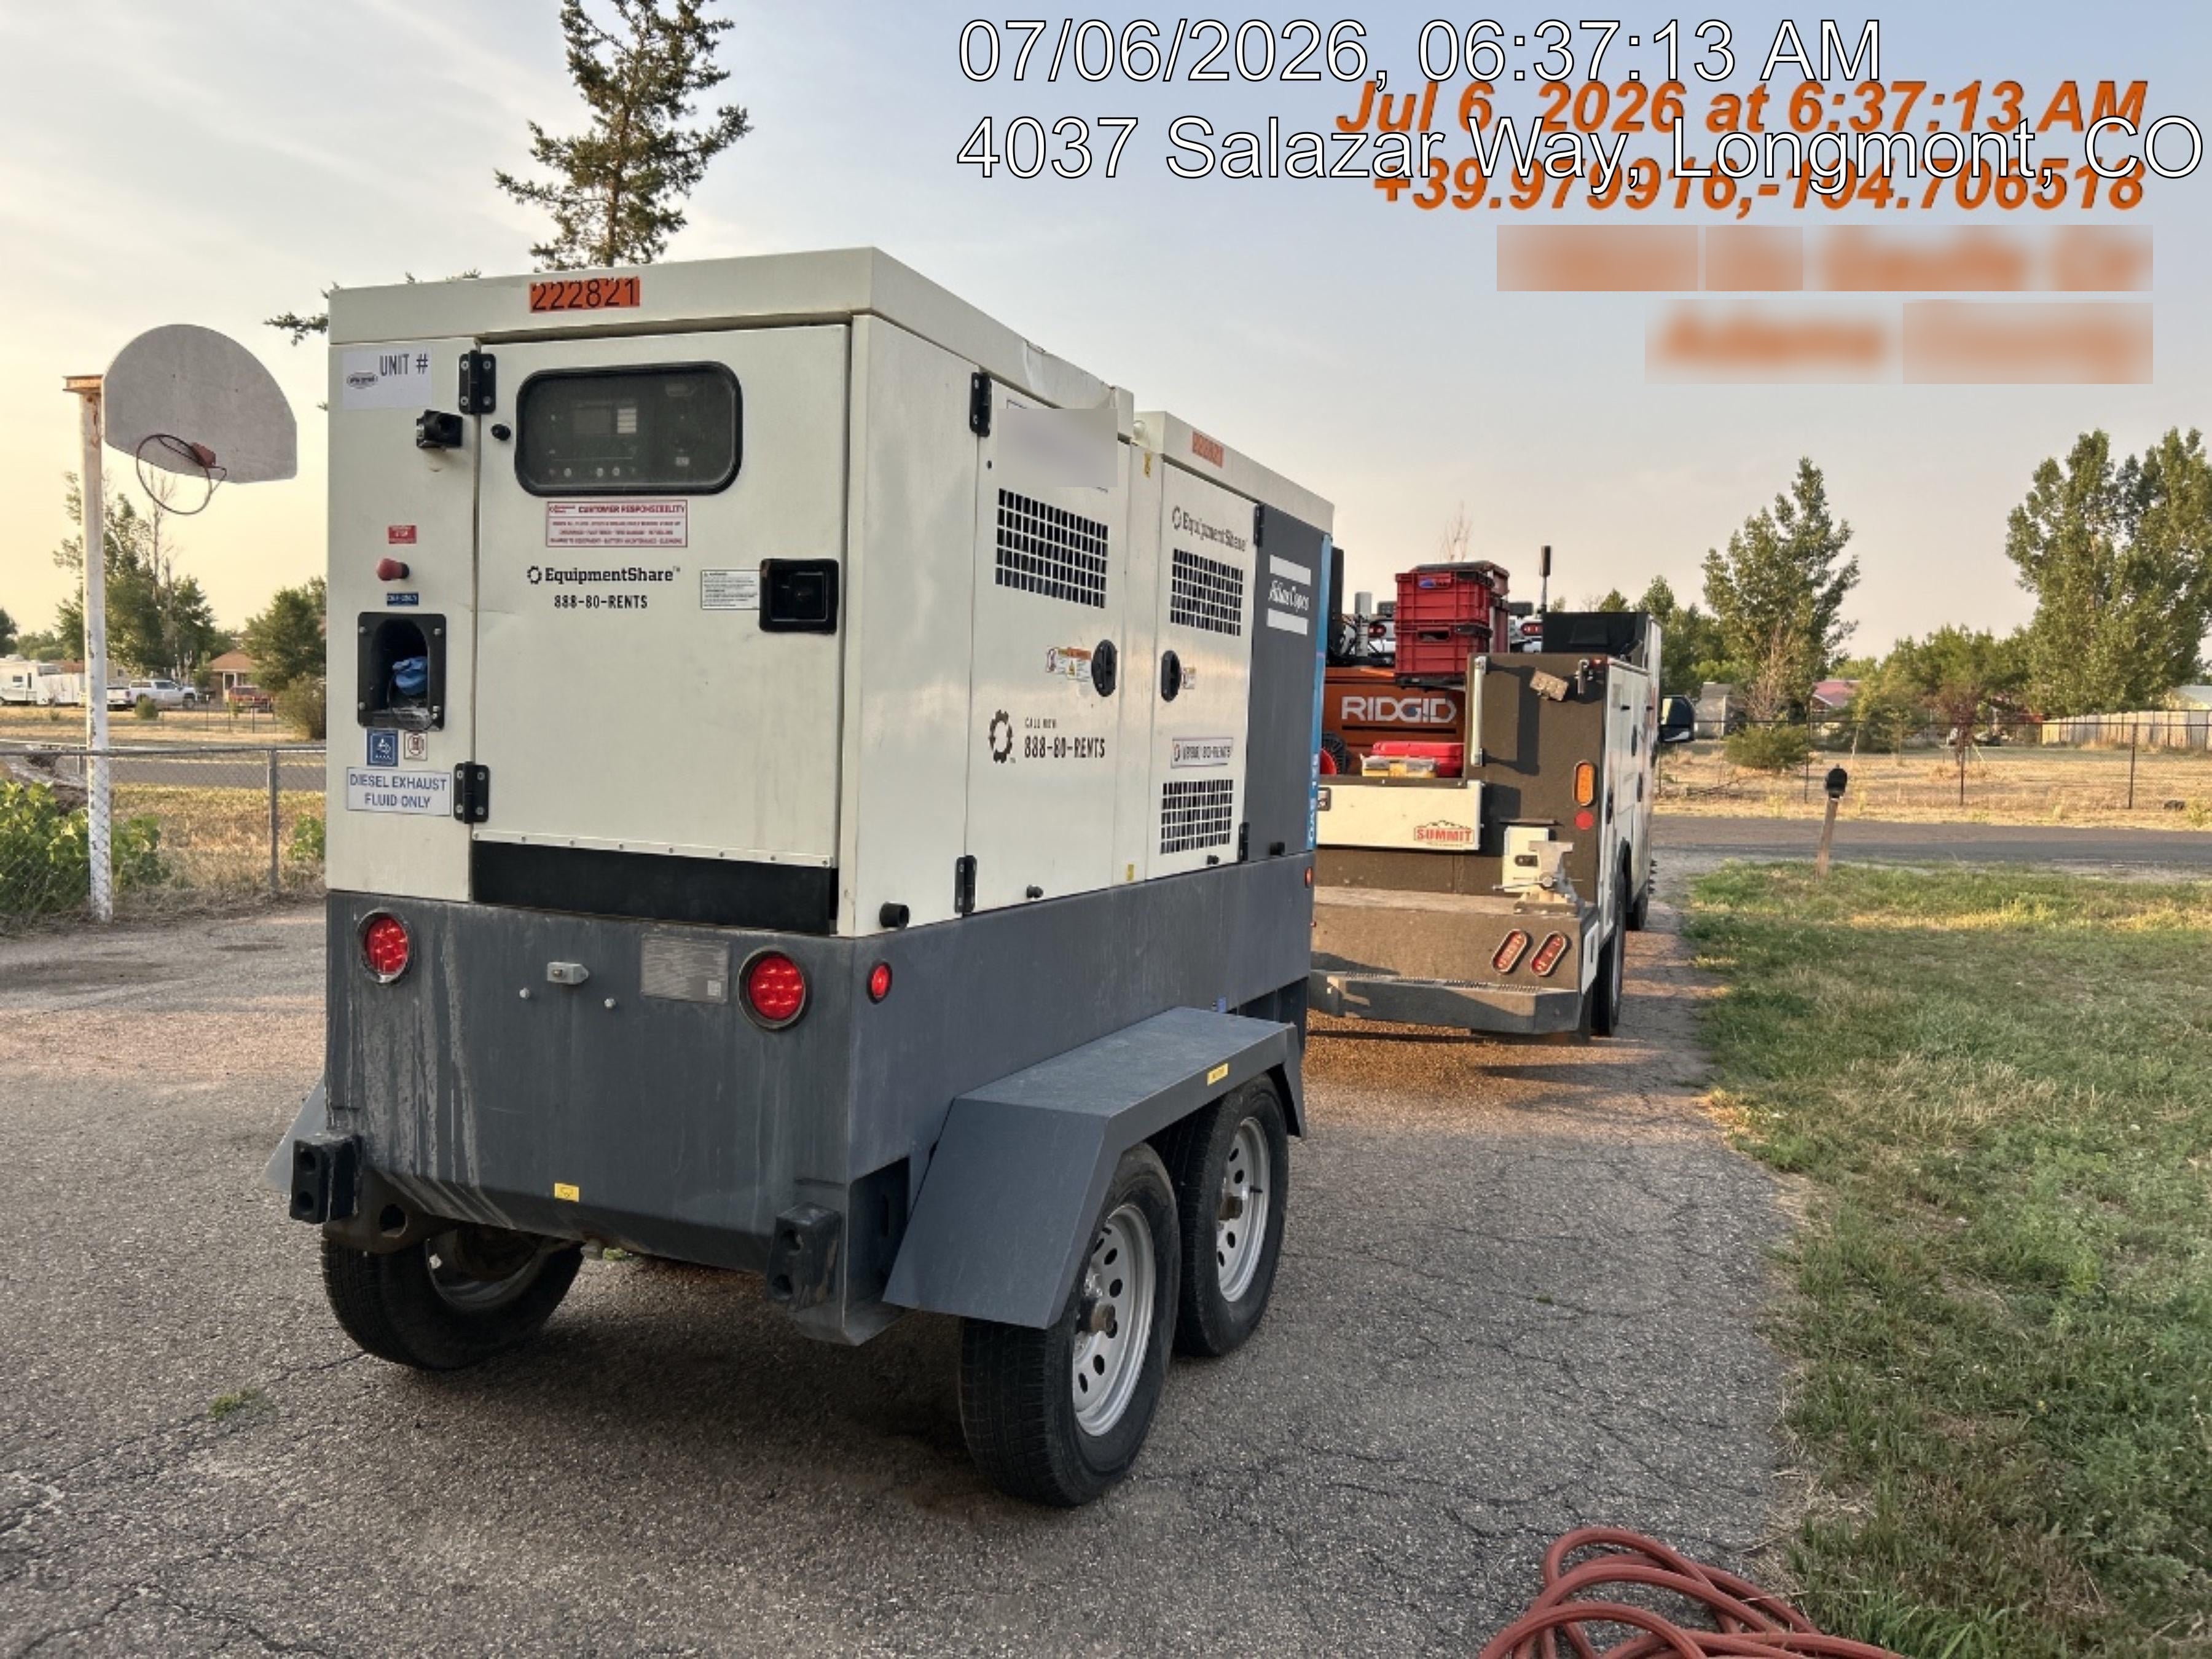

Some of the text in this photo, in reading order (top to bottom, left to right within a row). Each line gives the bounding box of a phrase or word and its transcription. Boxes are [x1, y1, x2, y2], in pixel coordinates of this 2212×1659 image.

[532, 278, 634, 310] 222821
[379, 353, 428, 377] UNIT #
[545, 567, 674, 584] EquipmentShare
[554, 594, 648, 609] 888-80-RENTS
[1341, 696, 1457, 723] RIDGID
[1024, 735, 1105, 759] 888-80-RENTS
[350, 774, 447, 791] DIESEL EXHAUST
[364, 792, 431, 809] FLUID ONLY
[1416, 829, 1472, 842] SUMMIT
